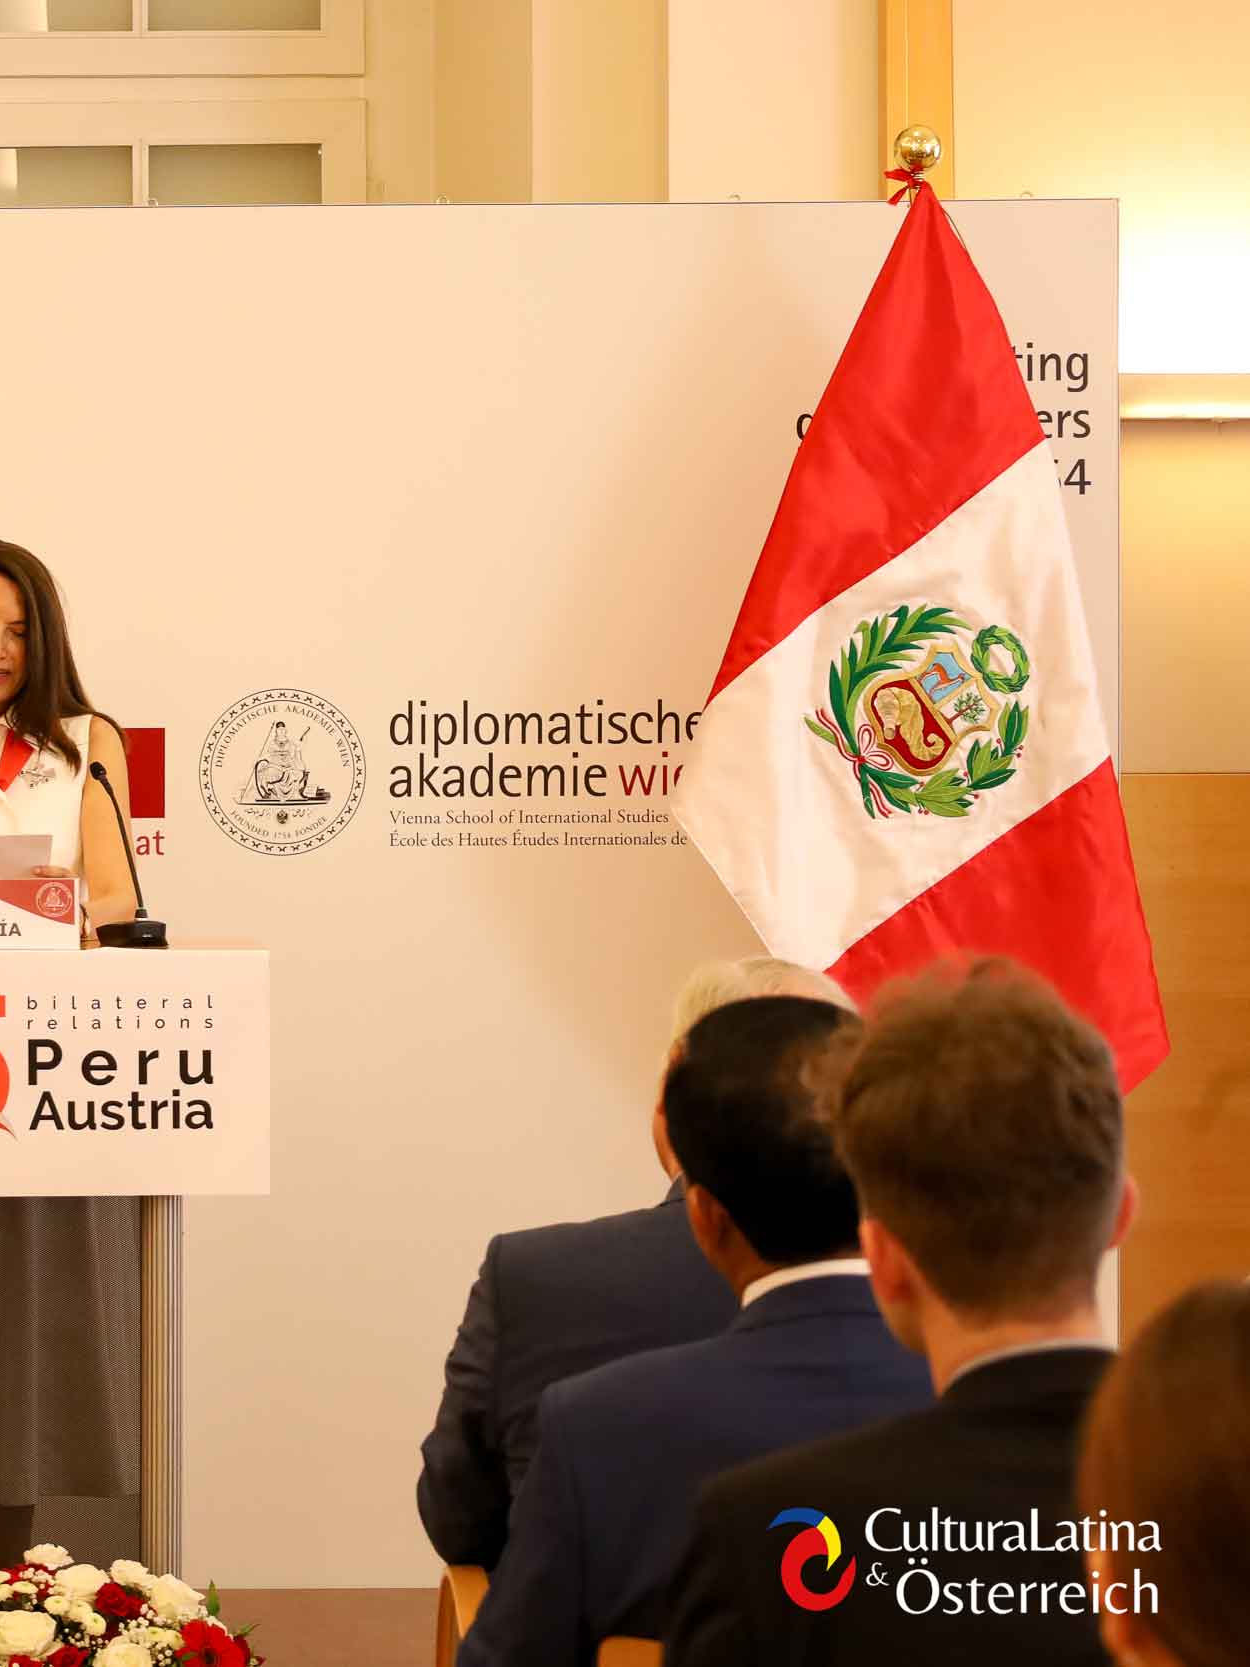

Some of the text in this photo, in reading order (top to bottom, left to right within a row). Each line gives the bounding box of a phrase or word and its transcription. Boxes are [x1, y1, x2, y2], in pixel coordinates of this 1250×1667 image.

[389, 699, 703, 758] diplomatische
[389, 751, 684, 798] akademie wi
[389, 808, 669, 825] Vienna School of International Studies
[389, 829, 687, 847] École des Hautes Études Internationales de
[27, 994, 213, 1011] bilateral
[27, 1015, 213, 1031] relations
[27, 1038, 213, 1087] Peru
[28, 1090, 213, 1131] Austria
